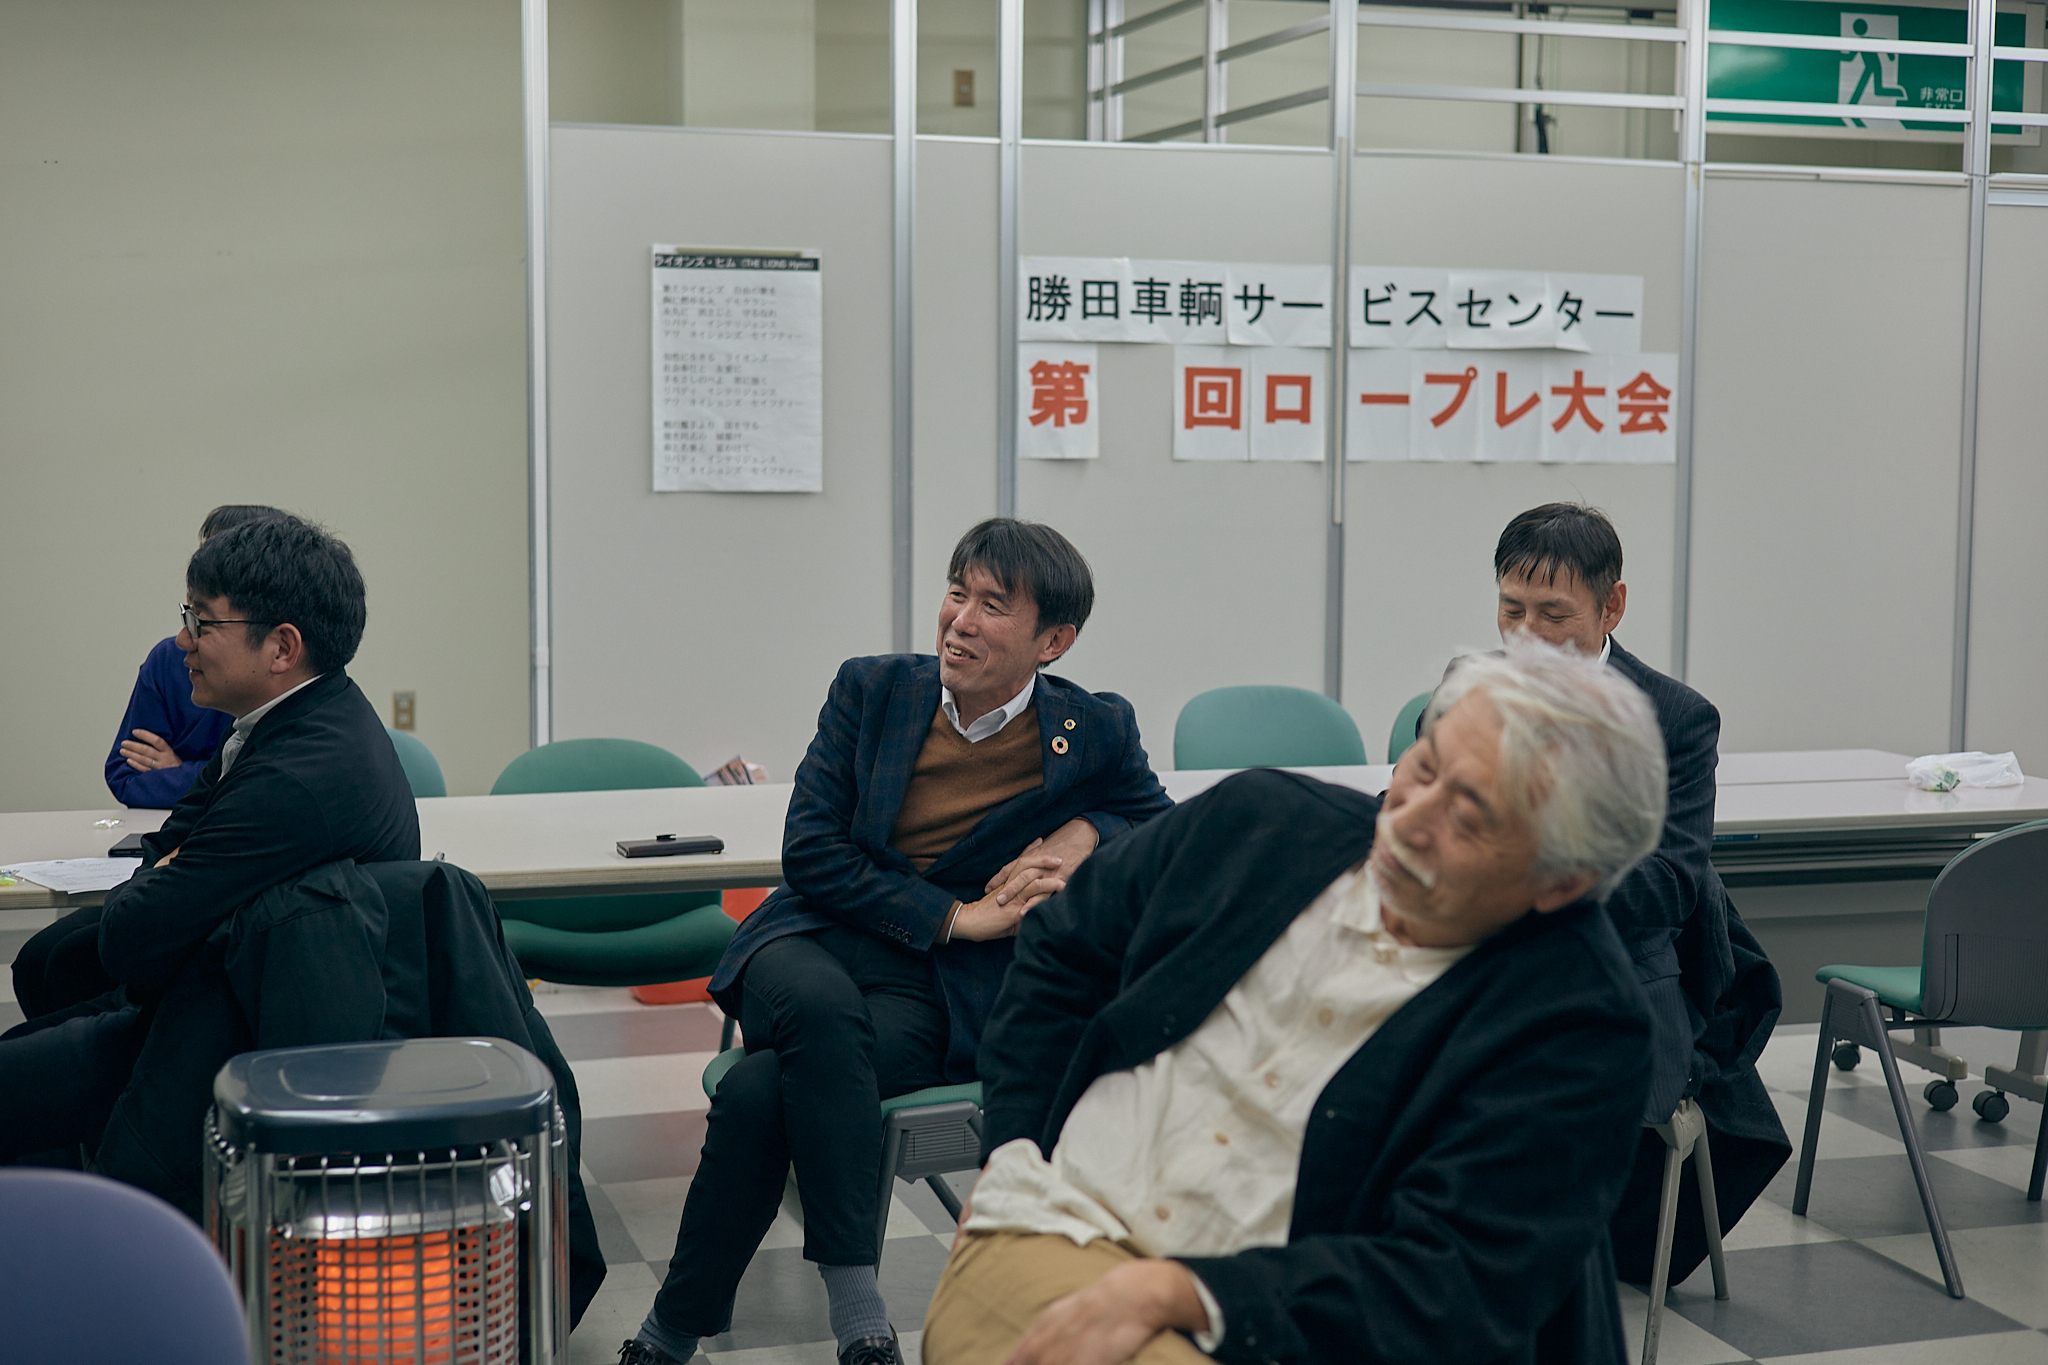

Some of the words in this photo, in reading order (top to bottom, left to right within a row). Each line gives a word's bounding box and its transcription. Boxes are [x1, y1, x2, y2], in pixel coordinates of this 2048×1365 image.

[1920, 87, 1963, 102] 非常口
[655, 256, 736, 268] ライオンズ・ヒム
[1027, 275, 1635, 331] 勝田車輌サービスセンター
[1028, 360, 1090, 429] 第
